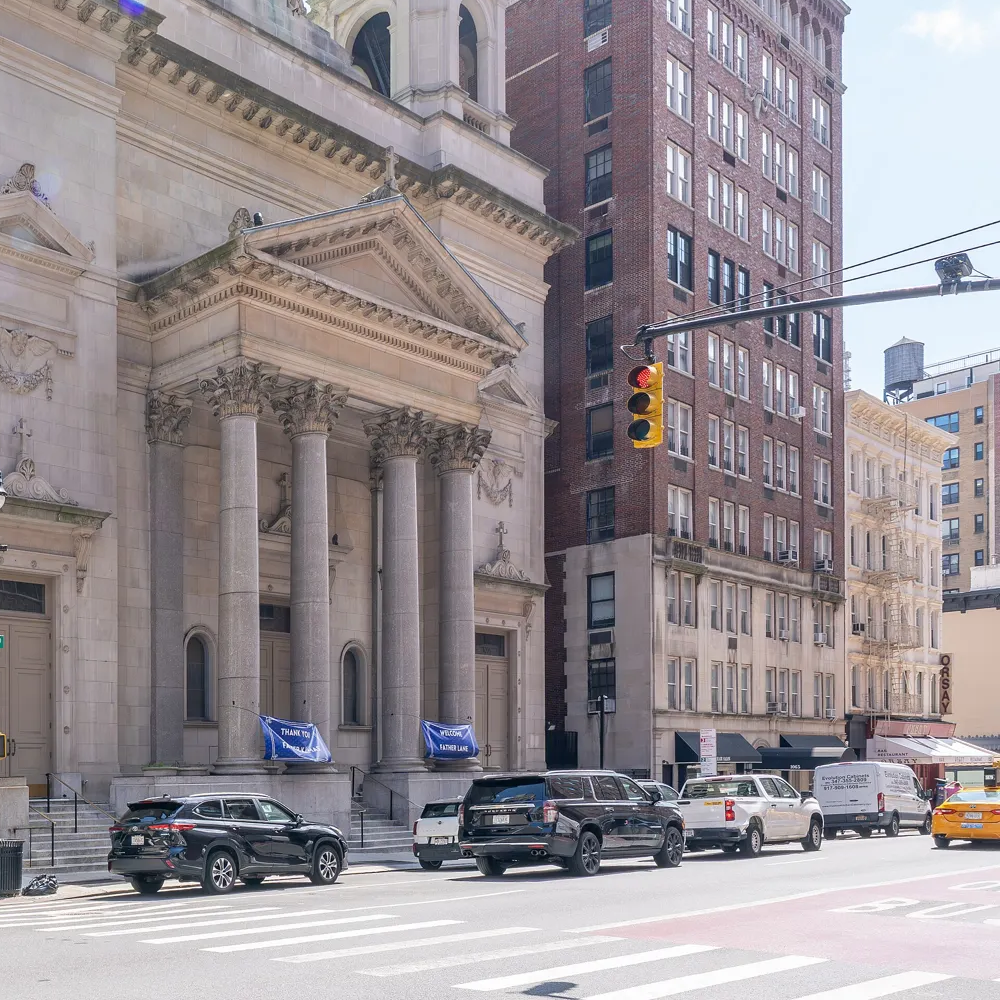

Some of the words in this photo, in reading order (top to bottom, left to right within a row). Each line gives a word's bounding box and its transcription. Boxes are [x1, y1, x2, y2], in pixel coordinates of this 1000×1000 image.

[941, 655, 950, 713] ORSAY
[281, 728, 300, 736] THANK
[301, 731, 311, 739] YOU
[440, 730, 463, 738] WELCOME
